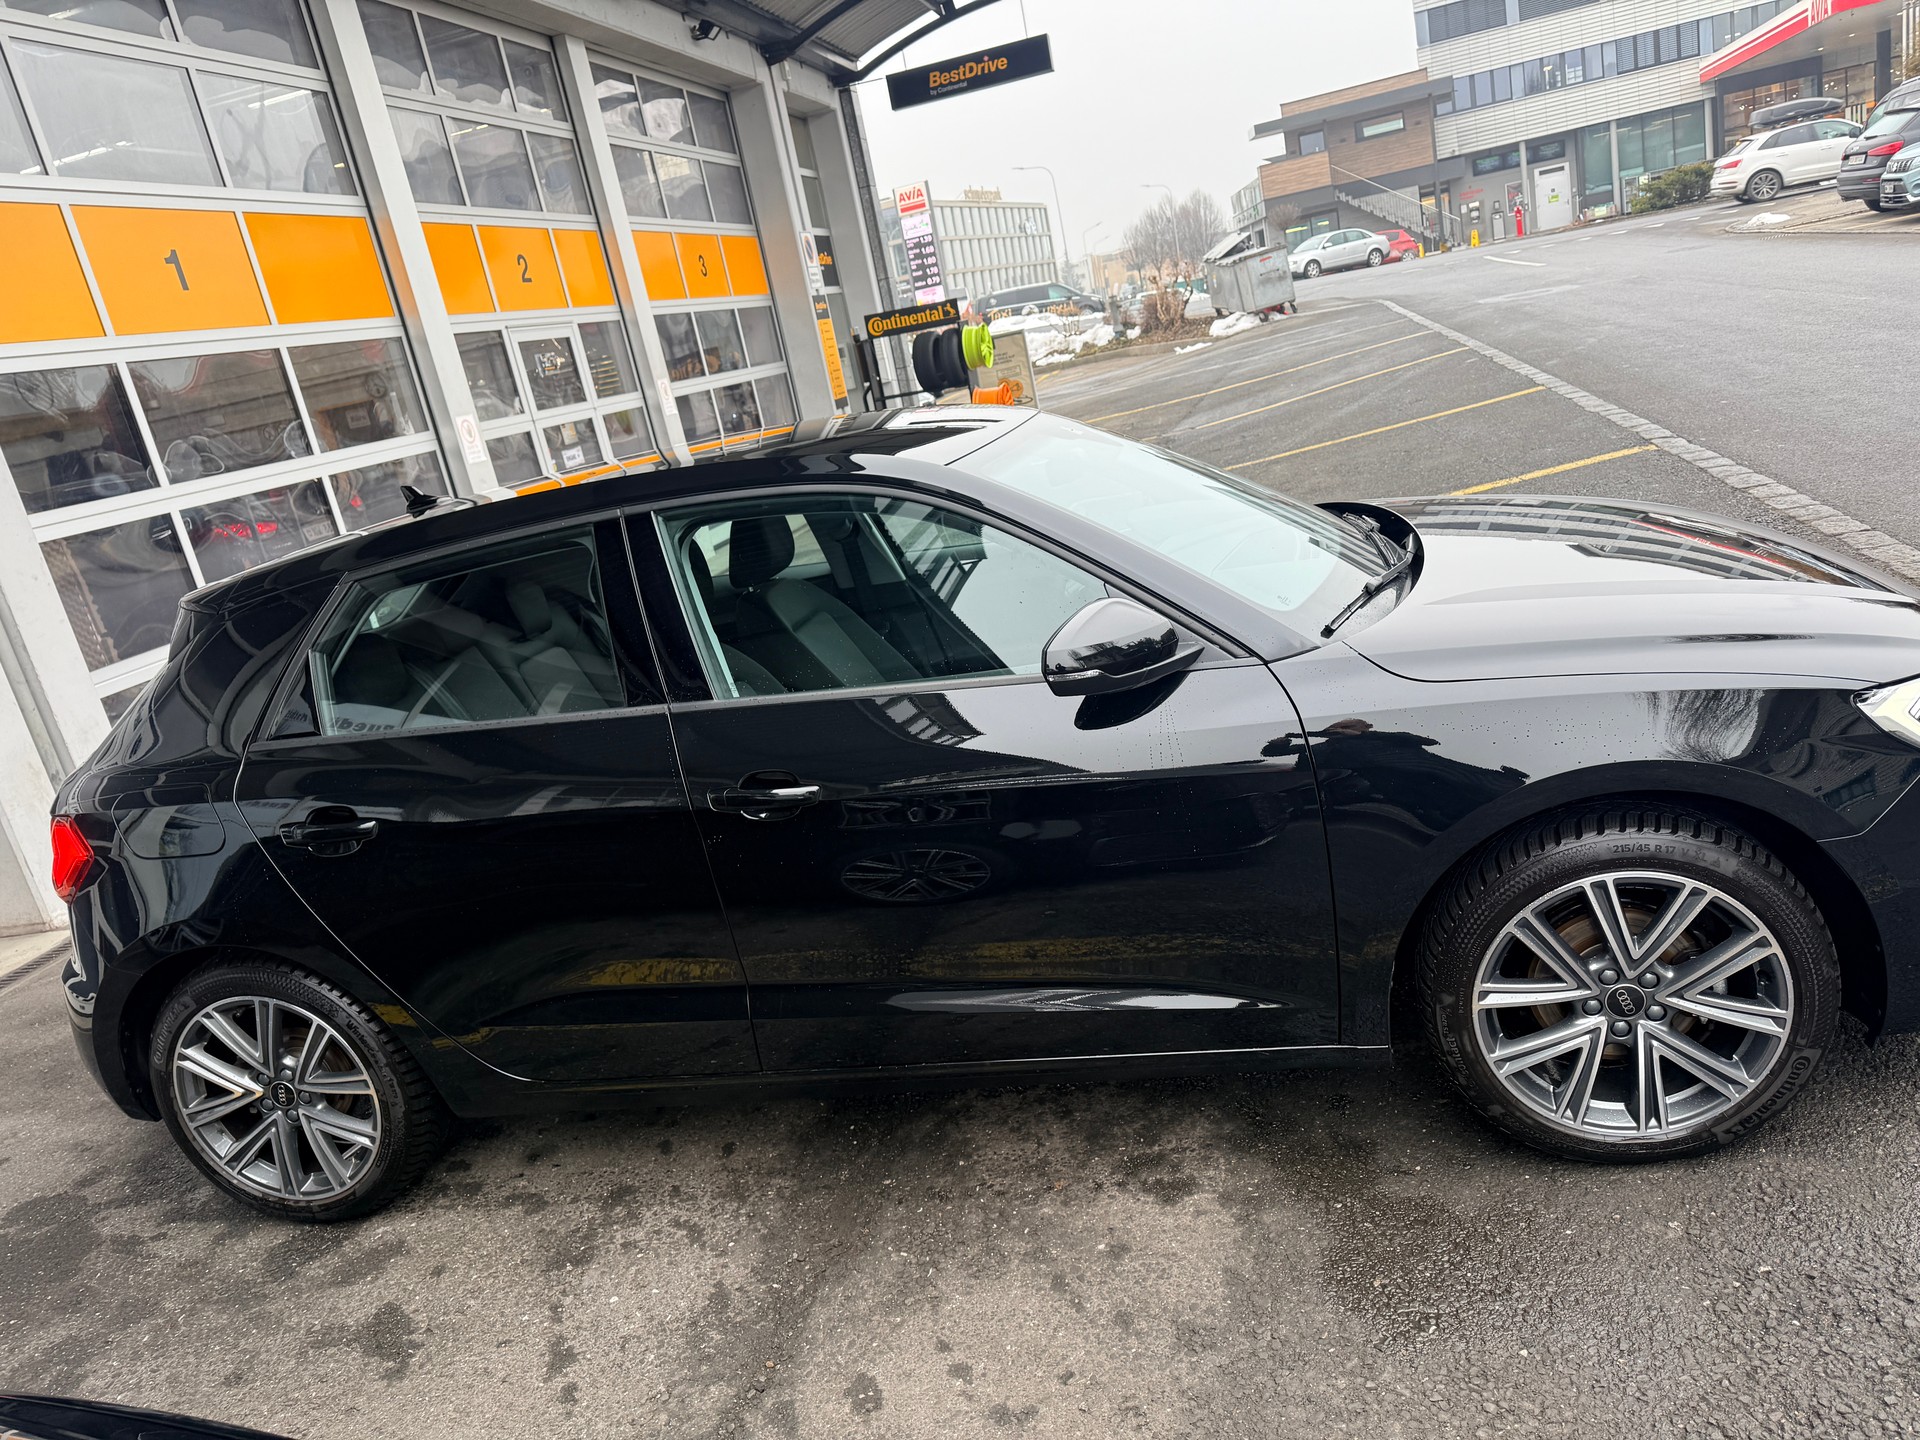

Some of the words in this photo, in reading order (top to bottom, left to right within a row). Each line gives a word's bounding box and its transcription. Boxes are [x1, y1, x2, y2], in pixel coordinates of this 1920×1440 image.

[928, 55, 1009, 88] BestDrive
[938, 81, 968, 93] Continental
[899, 186, 924, 203] AVIA
[164, 248, 190, 291] 1
[516, 253, 533, 284] 2
[697, 254, 708, 278] 3
[868, 305, 944, 337] Continental
[1612, 842, 1651, 854] 215/45
